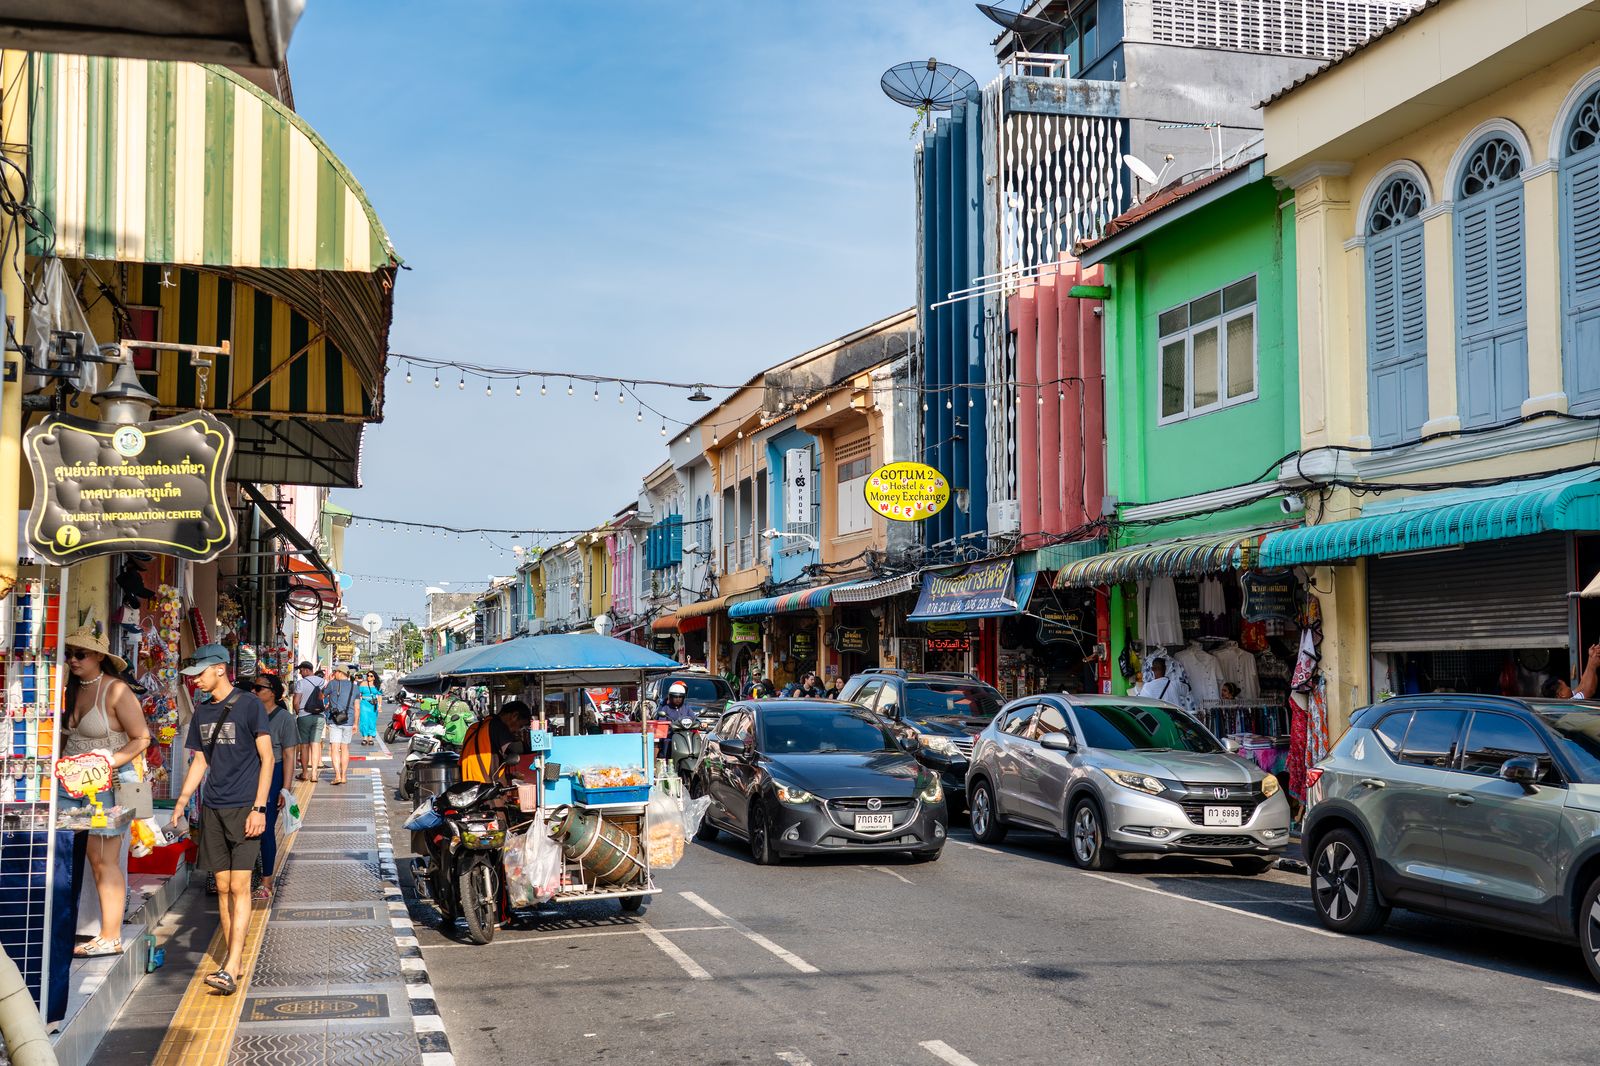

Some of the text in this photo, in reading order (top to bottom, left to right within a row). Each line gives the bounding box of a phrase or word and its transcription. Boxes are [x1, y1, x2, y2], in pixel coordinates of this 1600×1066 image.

[54, 456, 205, 483] ศูนย์บริการข้อมูลท่องเที่ยว
[880, 469, 934, 480] GOTUM 2
[890, 481, 917, 490] Hostel
[80, 482, 182, 502] เทศบาลนครภูเก็ต
[870, 491, 946, 505] Money Exchange
[61, 510, 202, 521] TOURIST INFORMATION CENTER
[1222, 809, 1240, 818] 6999
[873, 815, 891, 824] 6271
